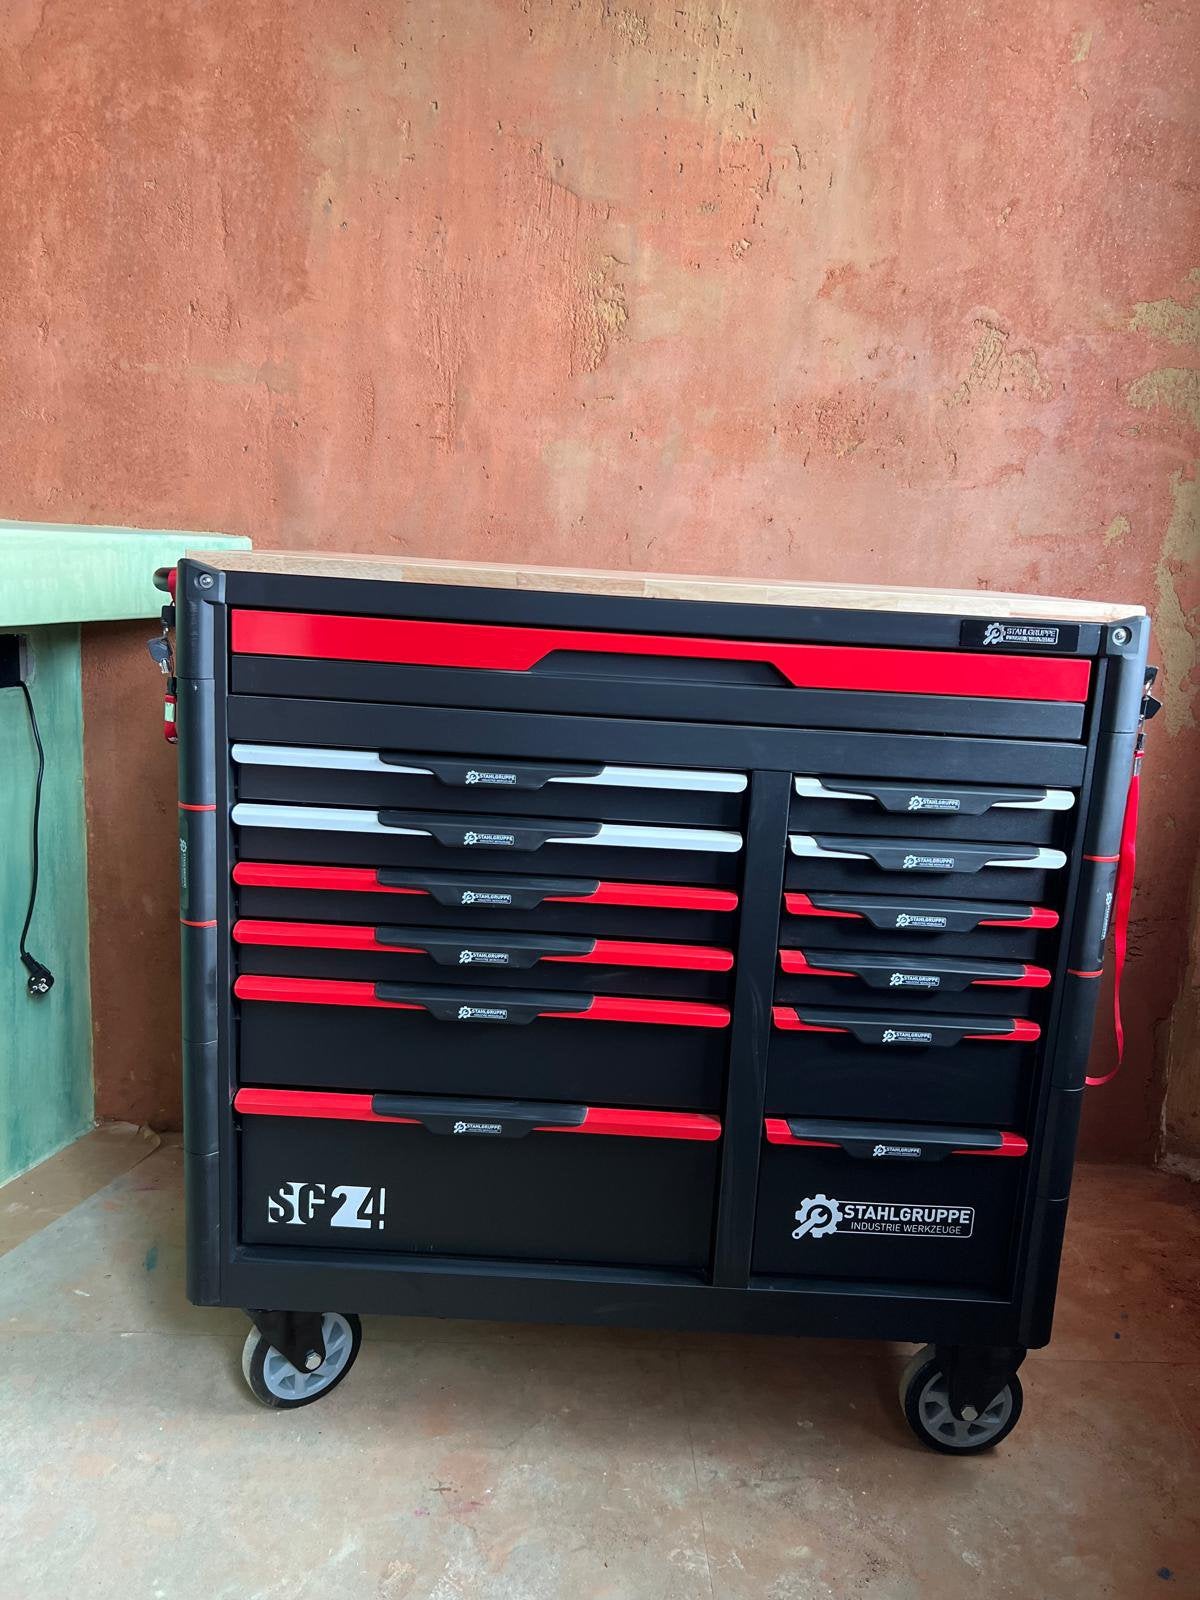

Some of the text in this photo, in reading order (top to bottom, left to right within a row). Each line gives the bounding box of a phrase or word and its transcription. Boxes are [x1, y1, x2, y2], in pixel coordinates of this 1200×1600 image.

[1006, 628, 1056, 637] STAHLGRUPPE
[843, 1205, 971, 1224] STAHLGRUPPE
[850, 1221, 962, 1235] INDUSTRIE WERKZEUGE
